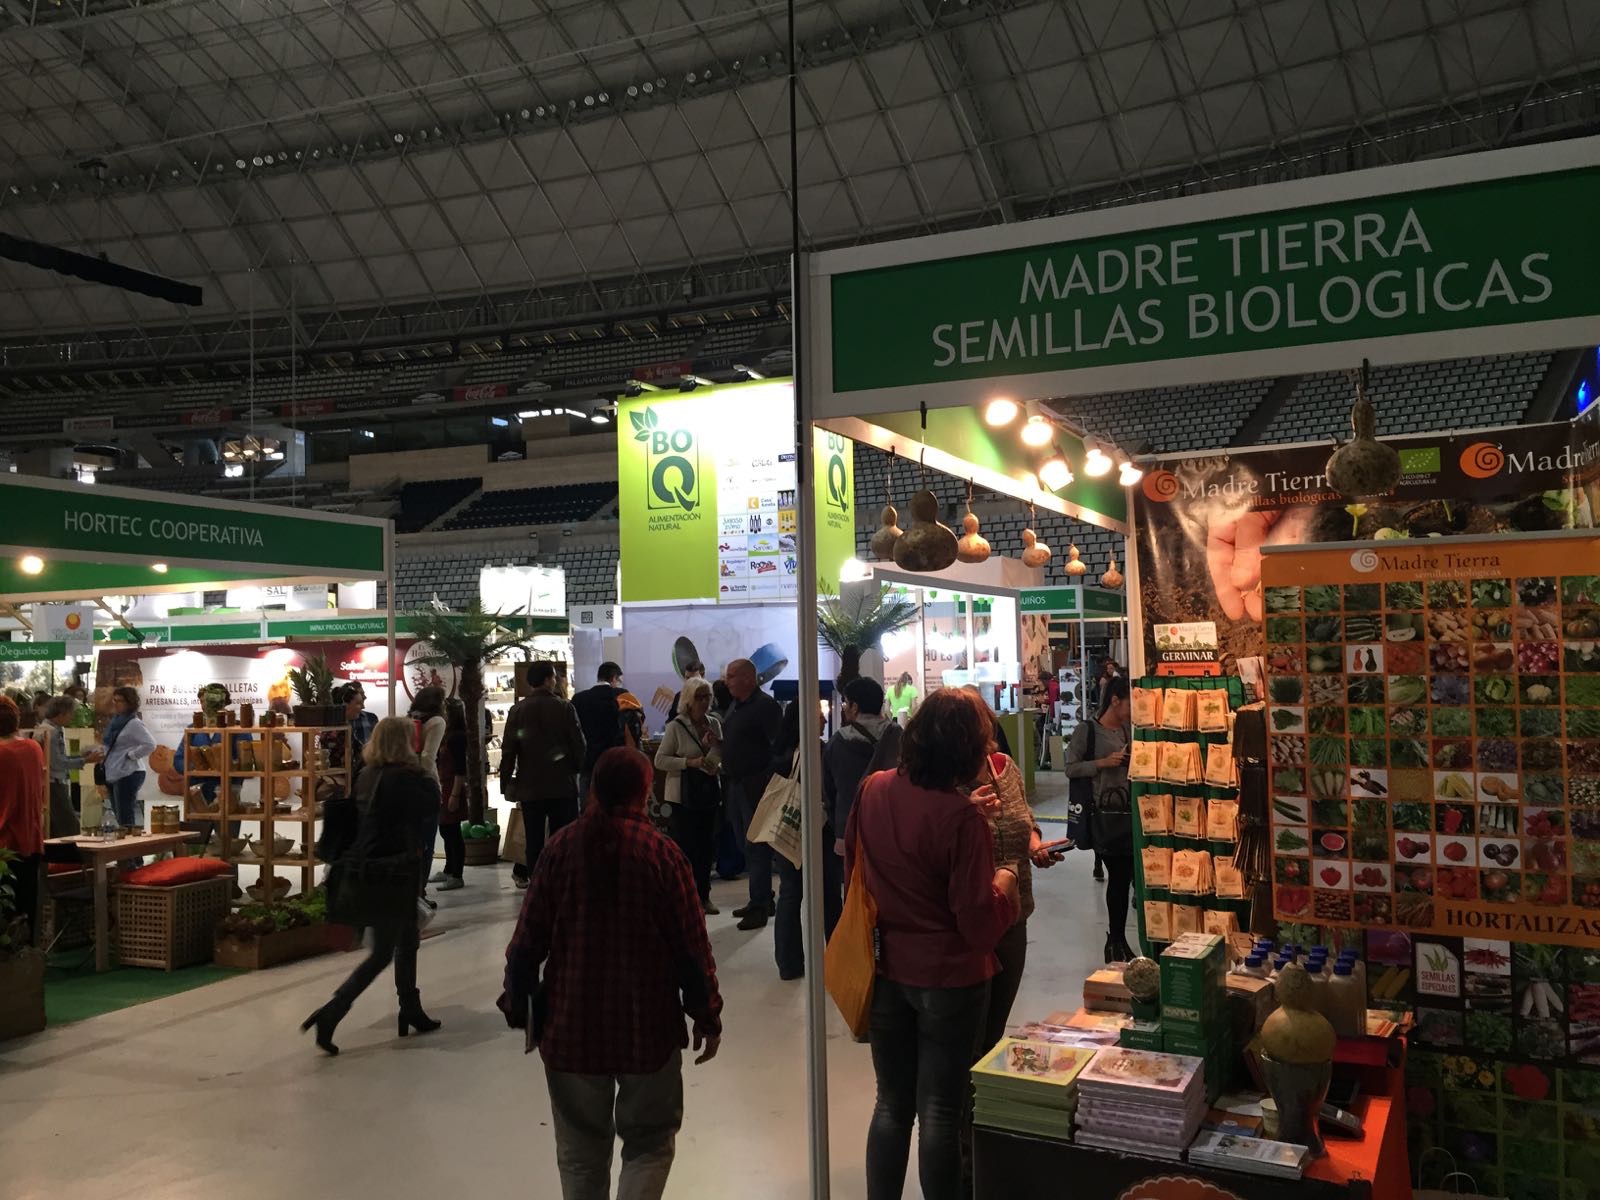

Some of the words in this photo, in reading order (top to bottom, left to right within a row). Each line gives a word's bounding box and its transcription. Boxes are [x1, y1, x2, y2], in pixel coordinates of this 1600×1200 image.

[1020, 238, 1199, 304] MADRE
[1218, 207, 1432, 278] TIERRA
[932, 299, 1164, 367] SEMILLAS
[1188, 252, 1553, 340] BIOLOGICAS
[653, 429, 692, 455] BO
[651, 455, 696, 512] Q
[1183, 475, 1259, 500] Madre
[1265, 471, 1331, 492] Tierr
[64, 510, 143, 537] HORTEC
[149, 518, 264, 548] COOPERATIVA
[648, 511, 701, 525] ALIMENTACIÓN
[648, 523, 681, 533] NATURAL
[1381, 554, 1438, 571] Madre
[1444, 552, 1500, 568] Tierra
[1162, 651, 1214, 661] GERMINAR
[150, 684, 165, 694] PAN
[1446, 908, 1600, 937] HORTALIZAS
[1420, 970, 1456, 983] SEMILLAS
[1421, 982, 1457, 994] ESPECIALES
